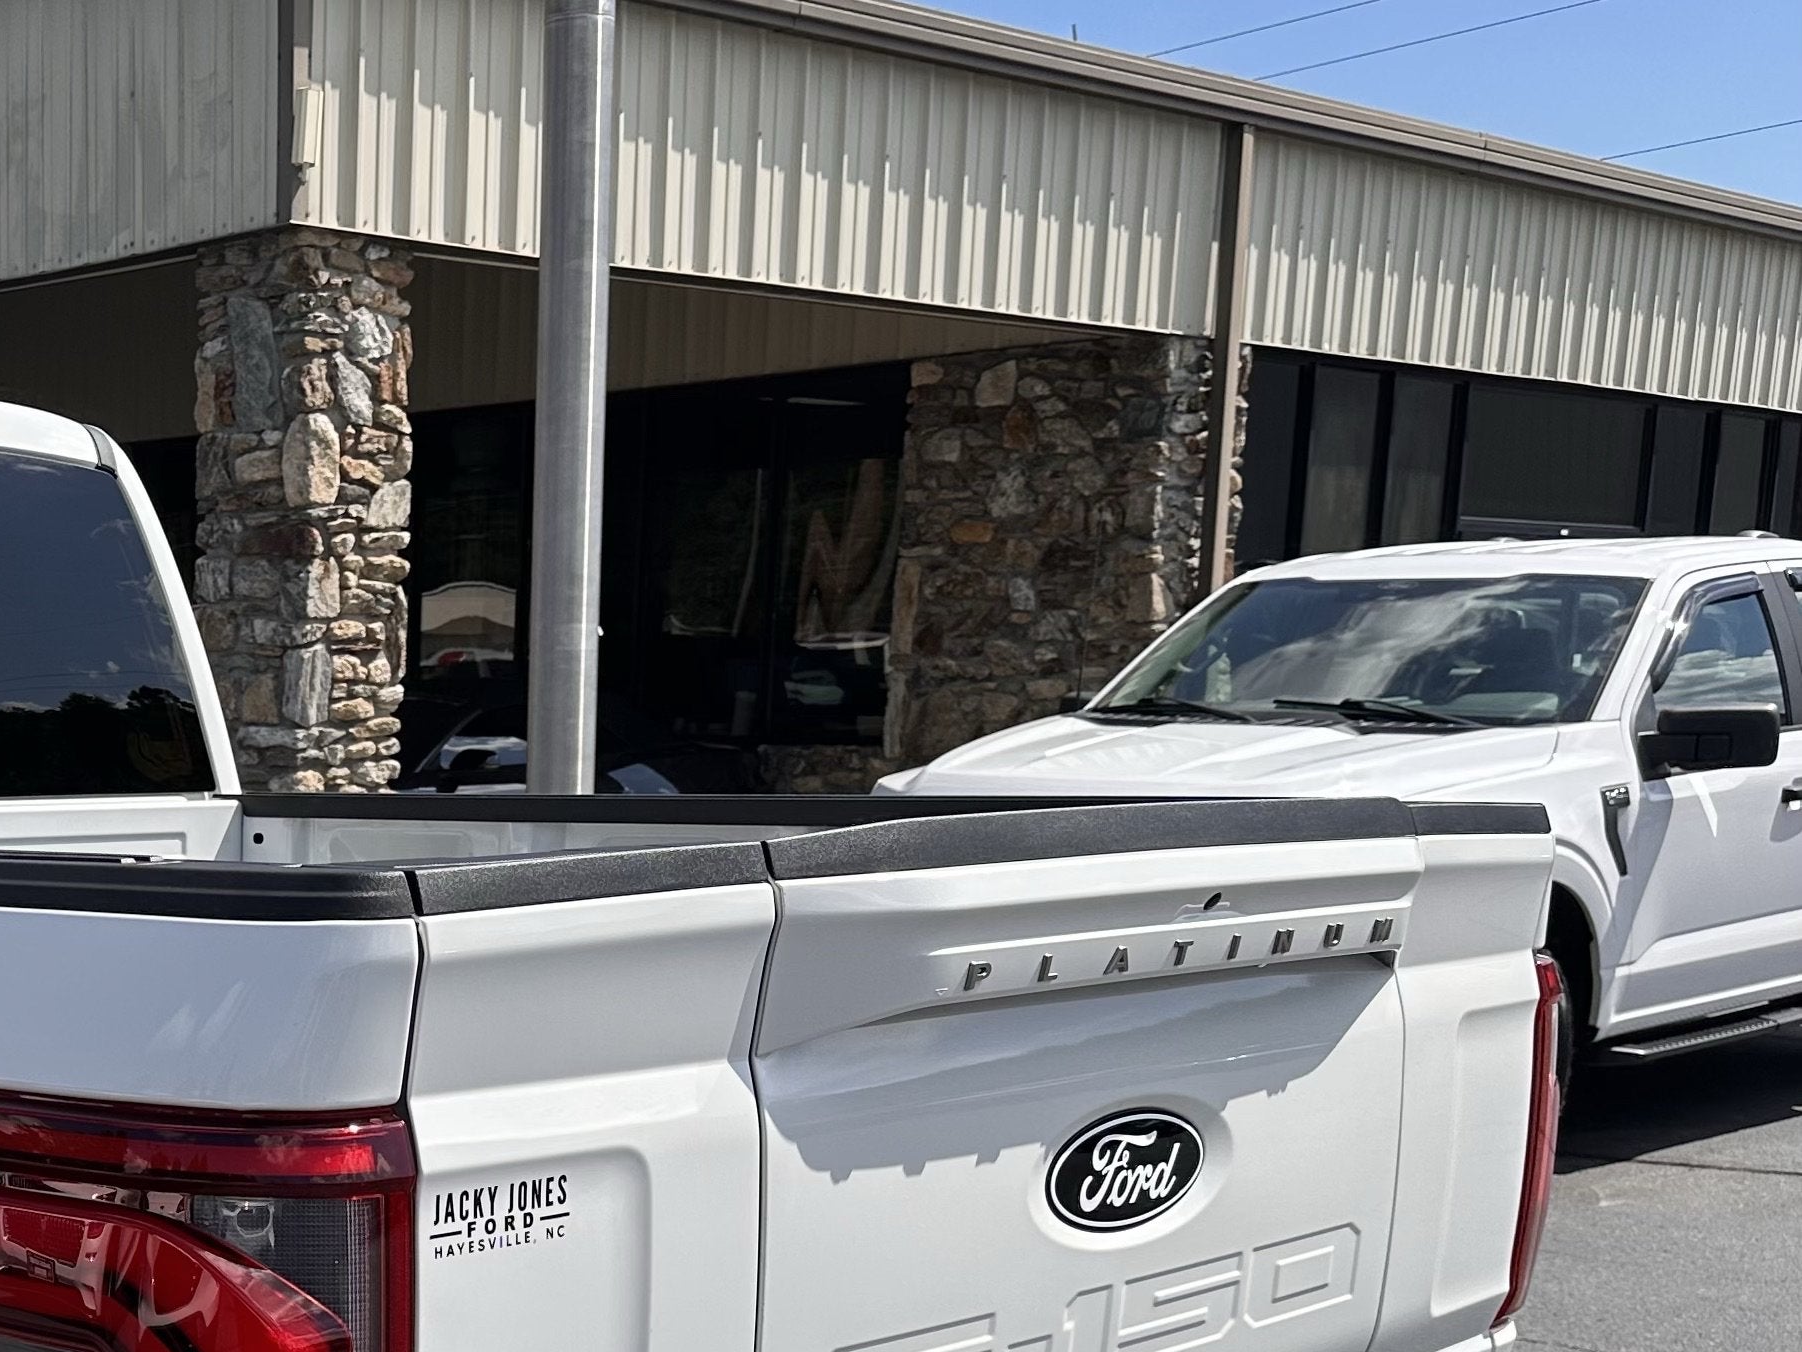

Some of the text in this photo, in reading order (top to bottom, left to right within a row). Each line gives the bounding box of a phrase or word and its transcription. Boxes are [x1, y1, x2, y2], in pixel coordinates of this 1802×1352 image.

[964, 915, 1395, 992] PLATINUM
[1079, 1130, 1181, 1213] Ford
[433, 1174, 568, 1226] JACKY JONES
[467, 1211, 534, 1238] FORD
[434, 1224, 566, 1260] HAYESVILLE, NC
